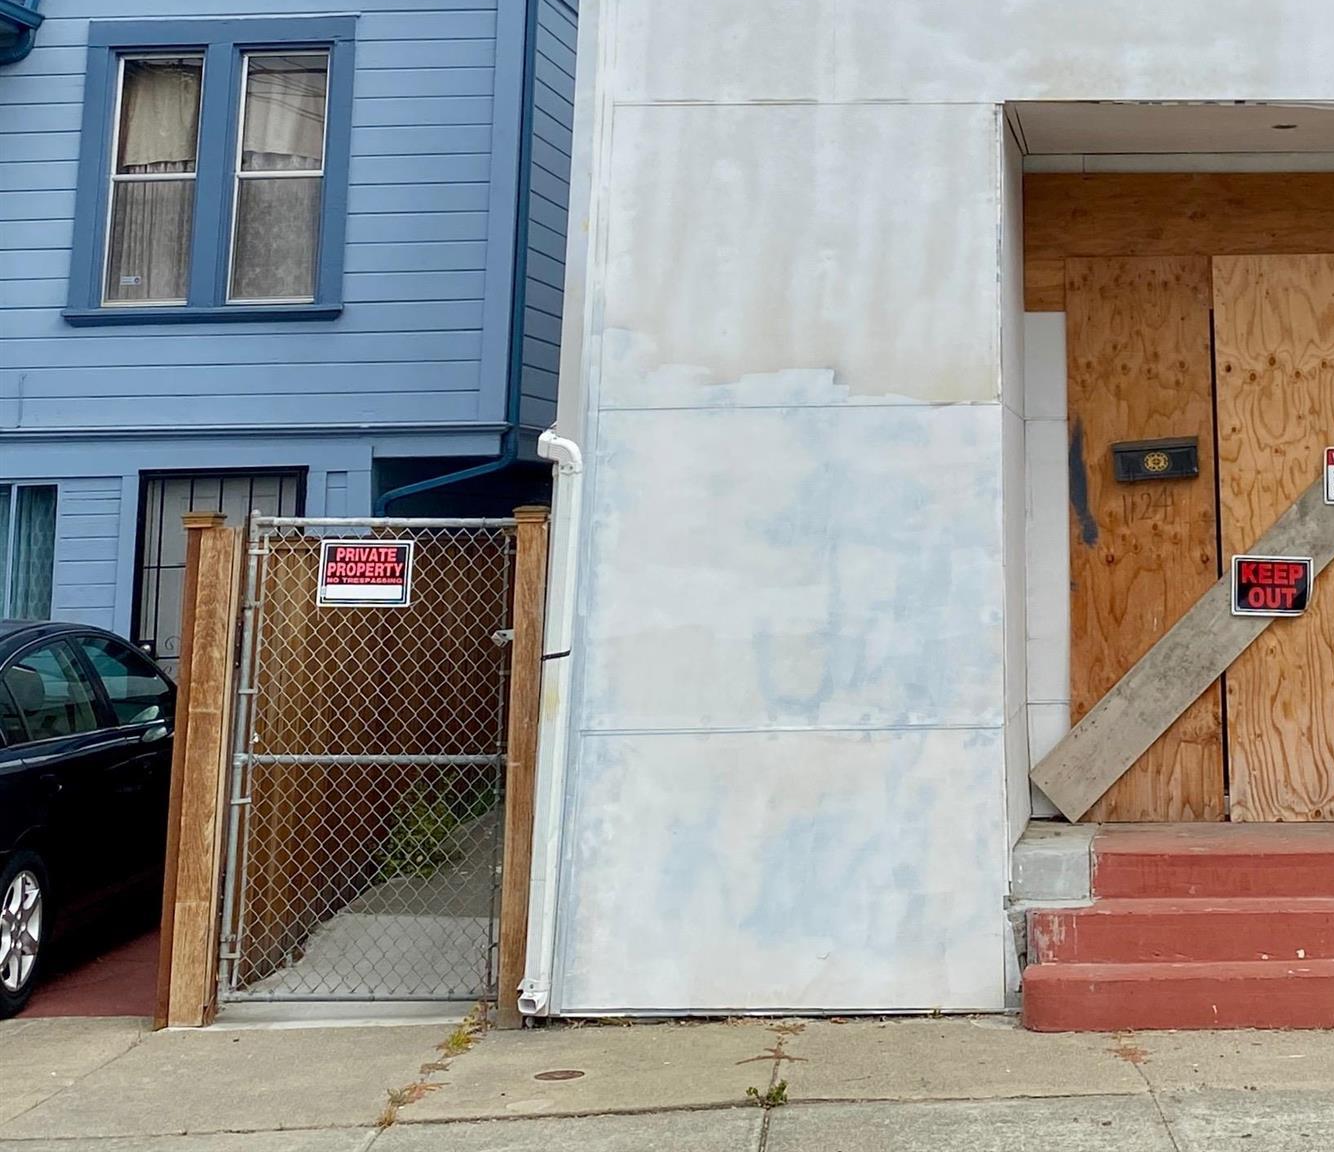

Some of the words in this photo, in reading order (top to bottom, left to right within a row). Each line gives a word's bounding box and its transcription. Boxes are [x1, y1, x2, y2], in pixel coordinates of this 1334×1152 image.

[336, 548, 397, 562] PRIVATE
[327, 562, 403, 576] PROPERTY
[1241, 563, 1304, 585] KEEP
[1248, 586, 1297, 608] OUT
